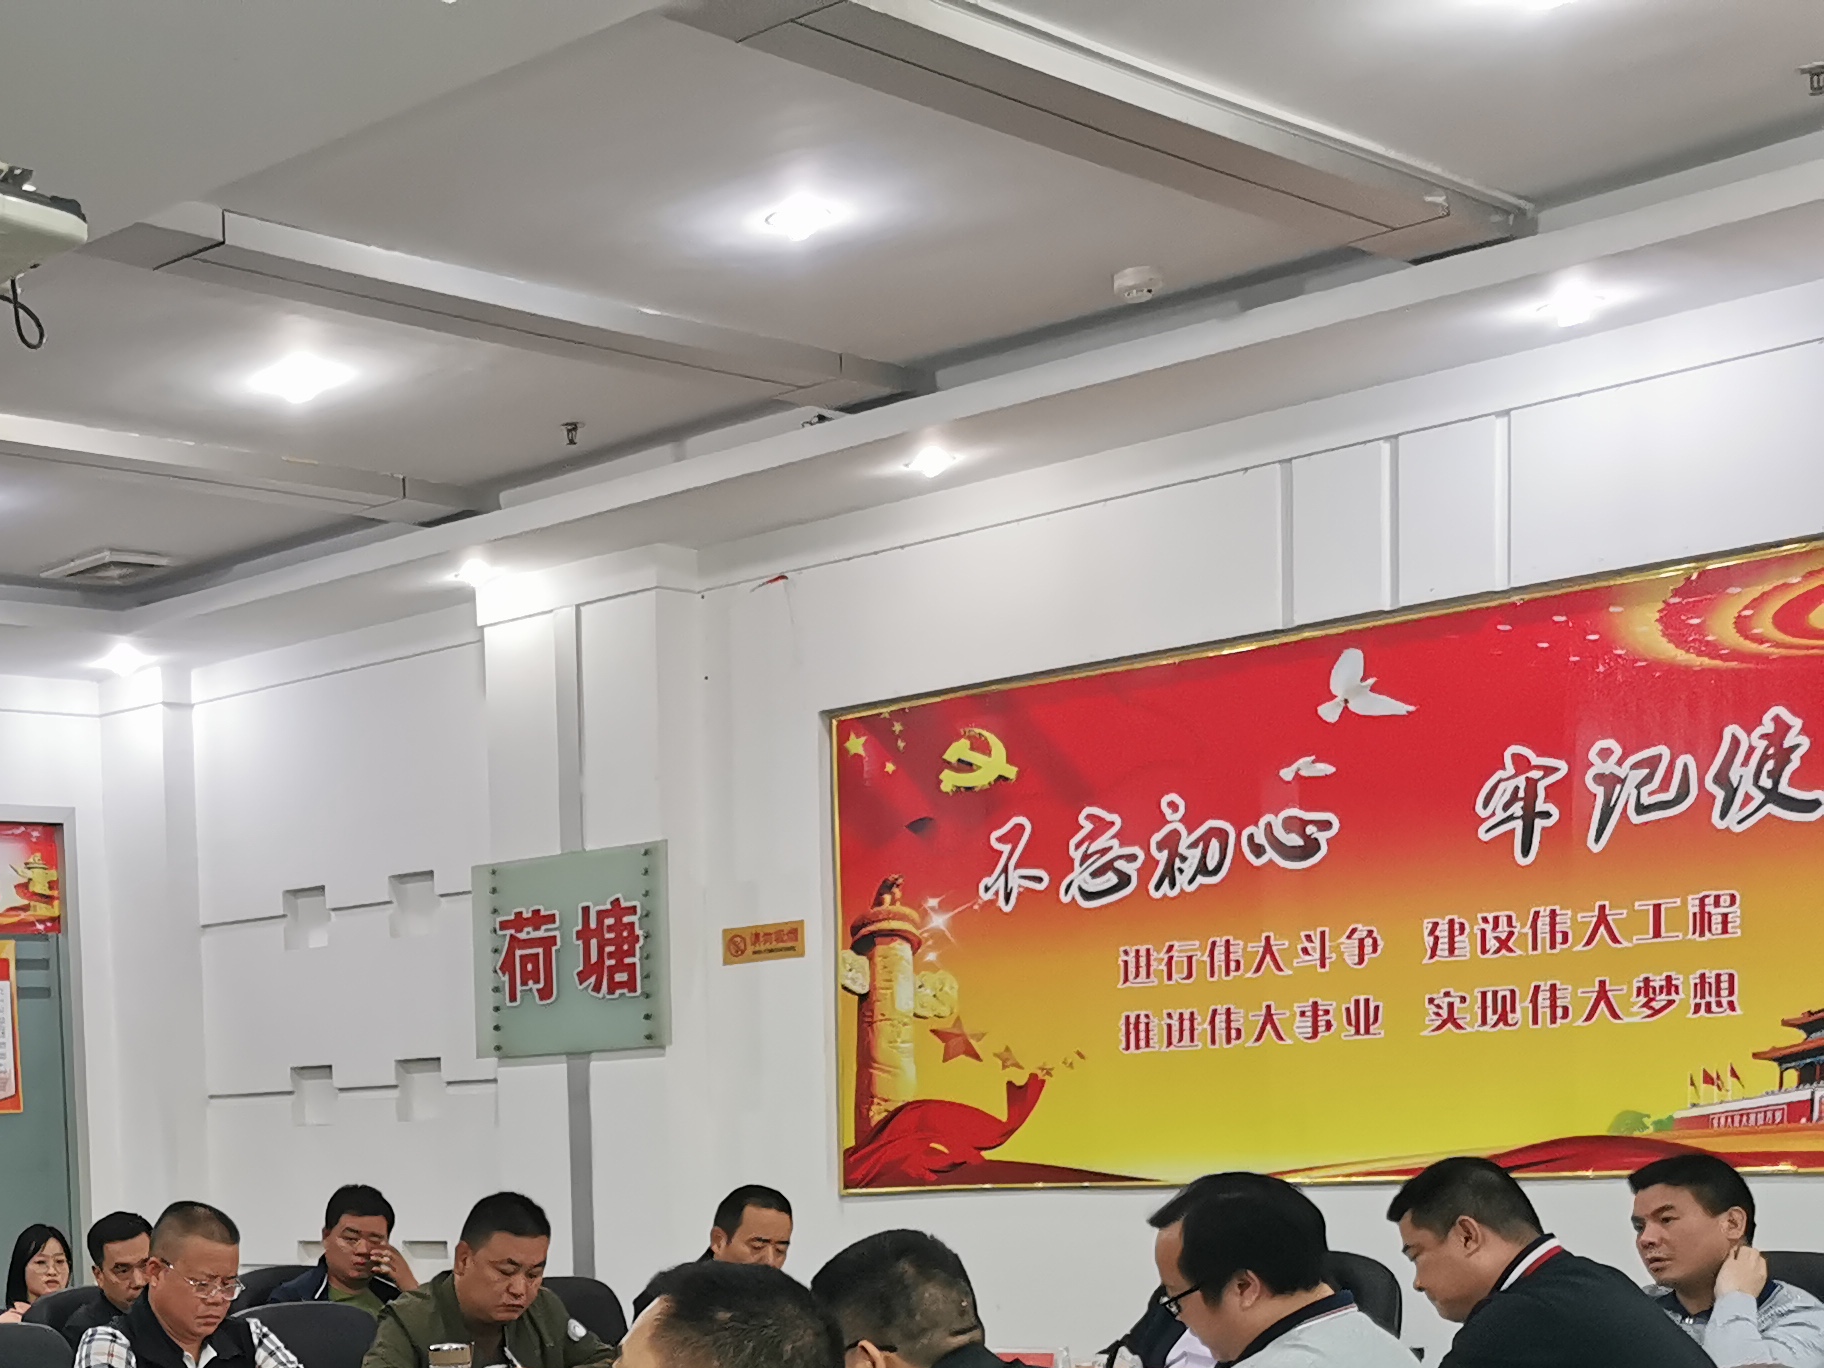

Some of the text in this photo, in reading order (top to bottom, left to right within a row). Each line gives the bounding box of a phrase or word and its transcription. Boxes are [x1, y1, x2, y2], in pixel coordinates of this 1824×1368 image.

[979, 705, 1824, 912] 不忘初心 牢记使
[496, 893, 643, 1006] 荷塘
[1117, 890, 1741, 987] 进行伟大斗争 建设伟大工程
[1119, 969, 1742, 1053] 推进伟大事业 实现伟大梦想
